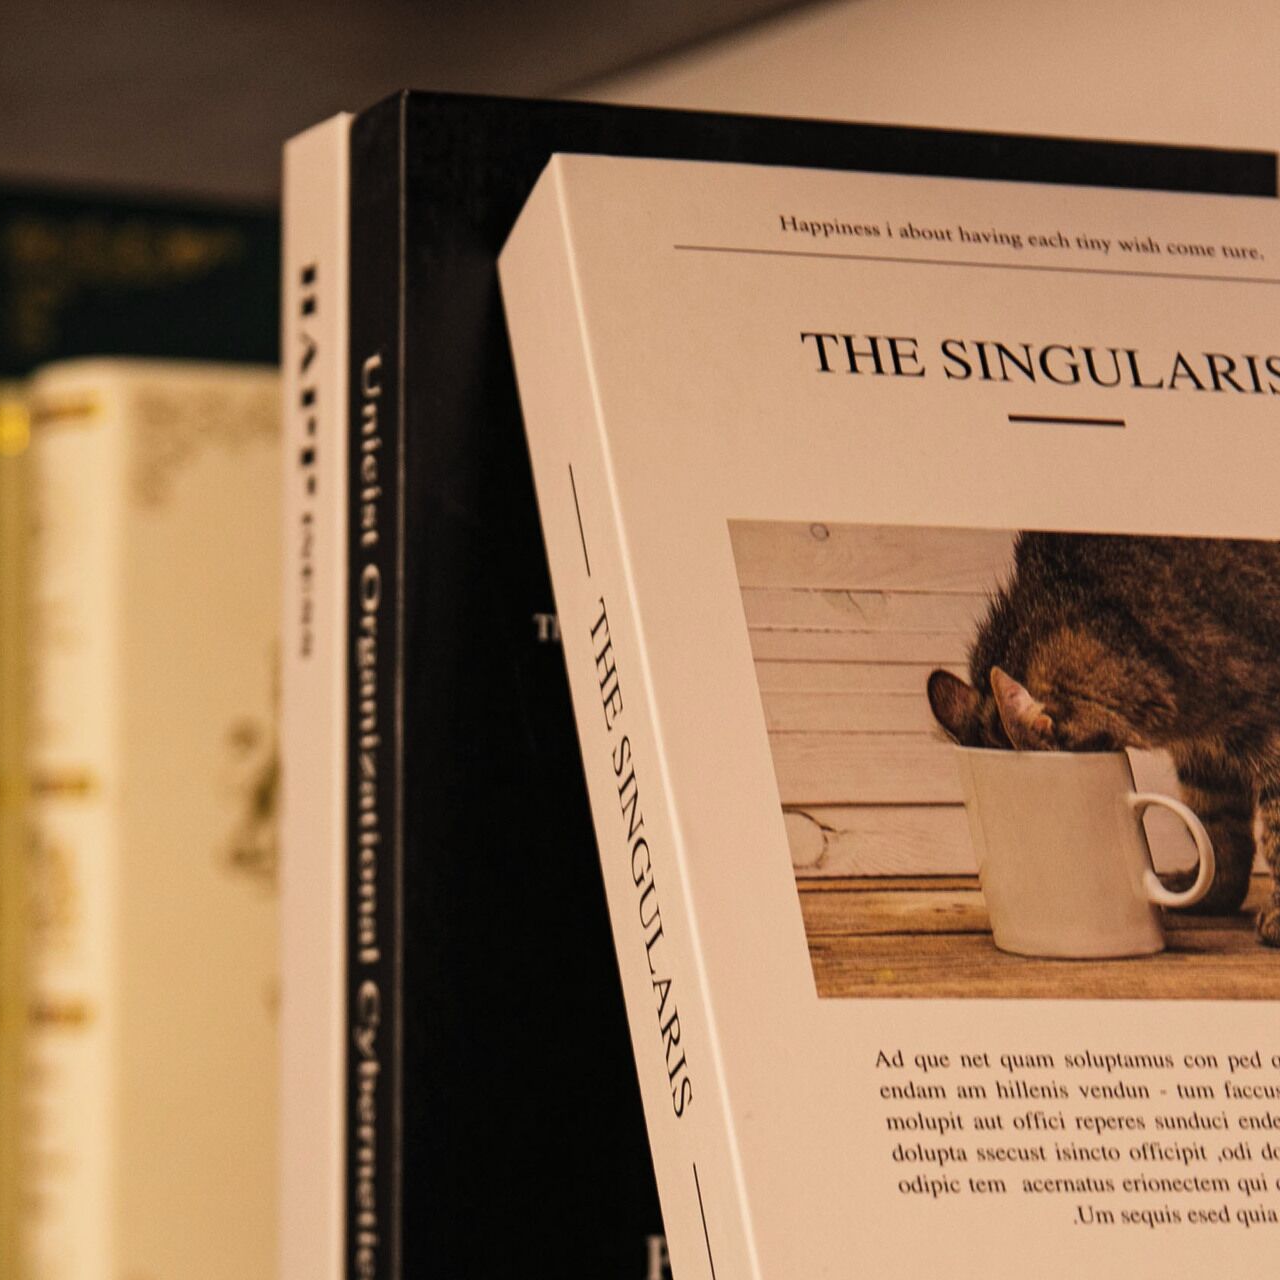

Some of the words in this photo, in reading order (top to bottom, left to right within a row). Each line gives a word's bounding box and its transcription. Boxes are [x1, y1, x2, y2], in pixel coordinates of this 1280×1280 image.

[779, 213, 881, 238] Happiness
[899, 221, 953, 242] about
[957, 223, 1023, 249] having
[1027, 229, 1071, 249] each
[1075, 233, 1111, 255] tiny
[1117, 234, 1161, 254] wish
[1166, 242, 1215, 257] come
[798, 331, 926, 378] THE
[588, 596, 625, 732] THE
[611, 734, 695, 1120] SINGULARIS
[875, 1047, 905, 1068] Ad
[914, 1053, 949, 1073] que
[960, 1050, 990, 1068] net
[1000, 1053, 1055, 1073] quam
[1064, 1047, 1175, 1073] soluptamus
[1183, 1053, 1219, 1069] con
[1227, 1048, 1262, 1074] ped
[879, 1078, 947, 1099] endam
[957, 1083, 987, 1099] am
[995, 1078, 1069, 1099] hillenis
[1078, 1078, 1150, 1099] vendun
[1176, 1081, 1215, 1099] tum
[886, 1110, 964, 1135] molupit
[973, 1112, 1003, 1130] aut
[1012, 1110, 1066, 1130] offici
[1075, 1114, 1146, 1135] reperes
[1154, 1109, 1229, 1130] sunduci
[891, 1141, 968, 1167] dolupta
[976, 1143, 1046, 1162] ssecust
[1055, 1140, 1121, 1161] isincto
[1129, 1141, 1207, 1166] officipit
[898, 1173, 960, 1199] odipic
[968, 1175, 1007, 1193] tem
[1022, 1175, 1115, 1193] acernatus
[1237, 1173, 1268, 1197] qui
[1120, 1205, 1182, 1229] sequis
[1187, 1202, 1231, 1224] esed
[1236, 1204, 1279, 1229] quia
